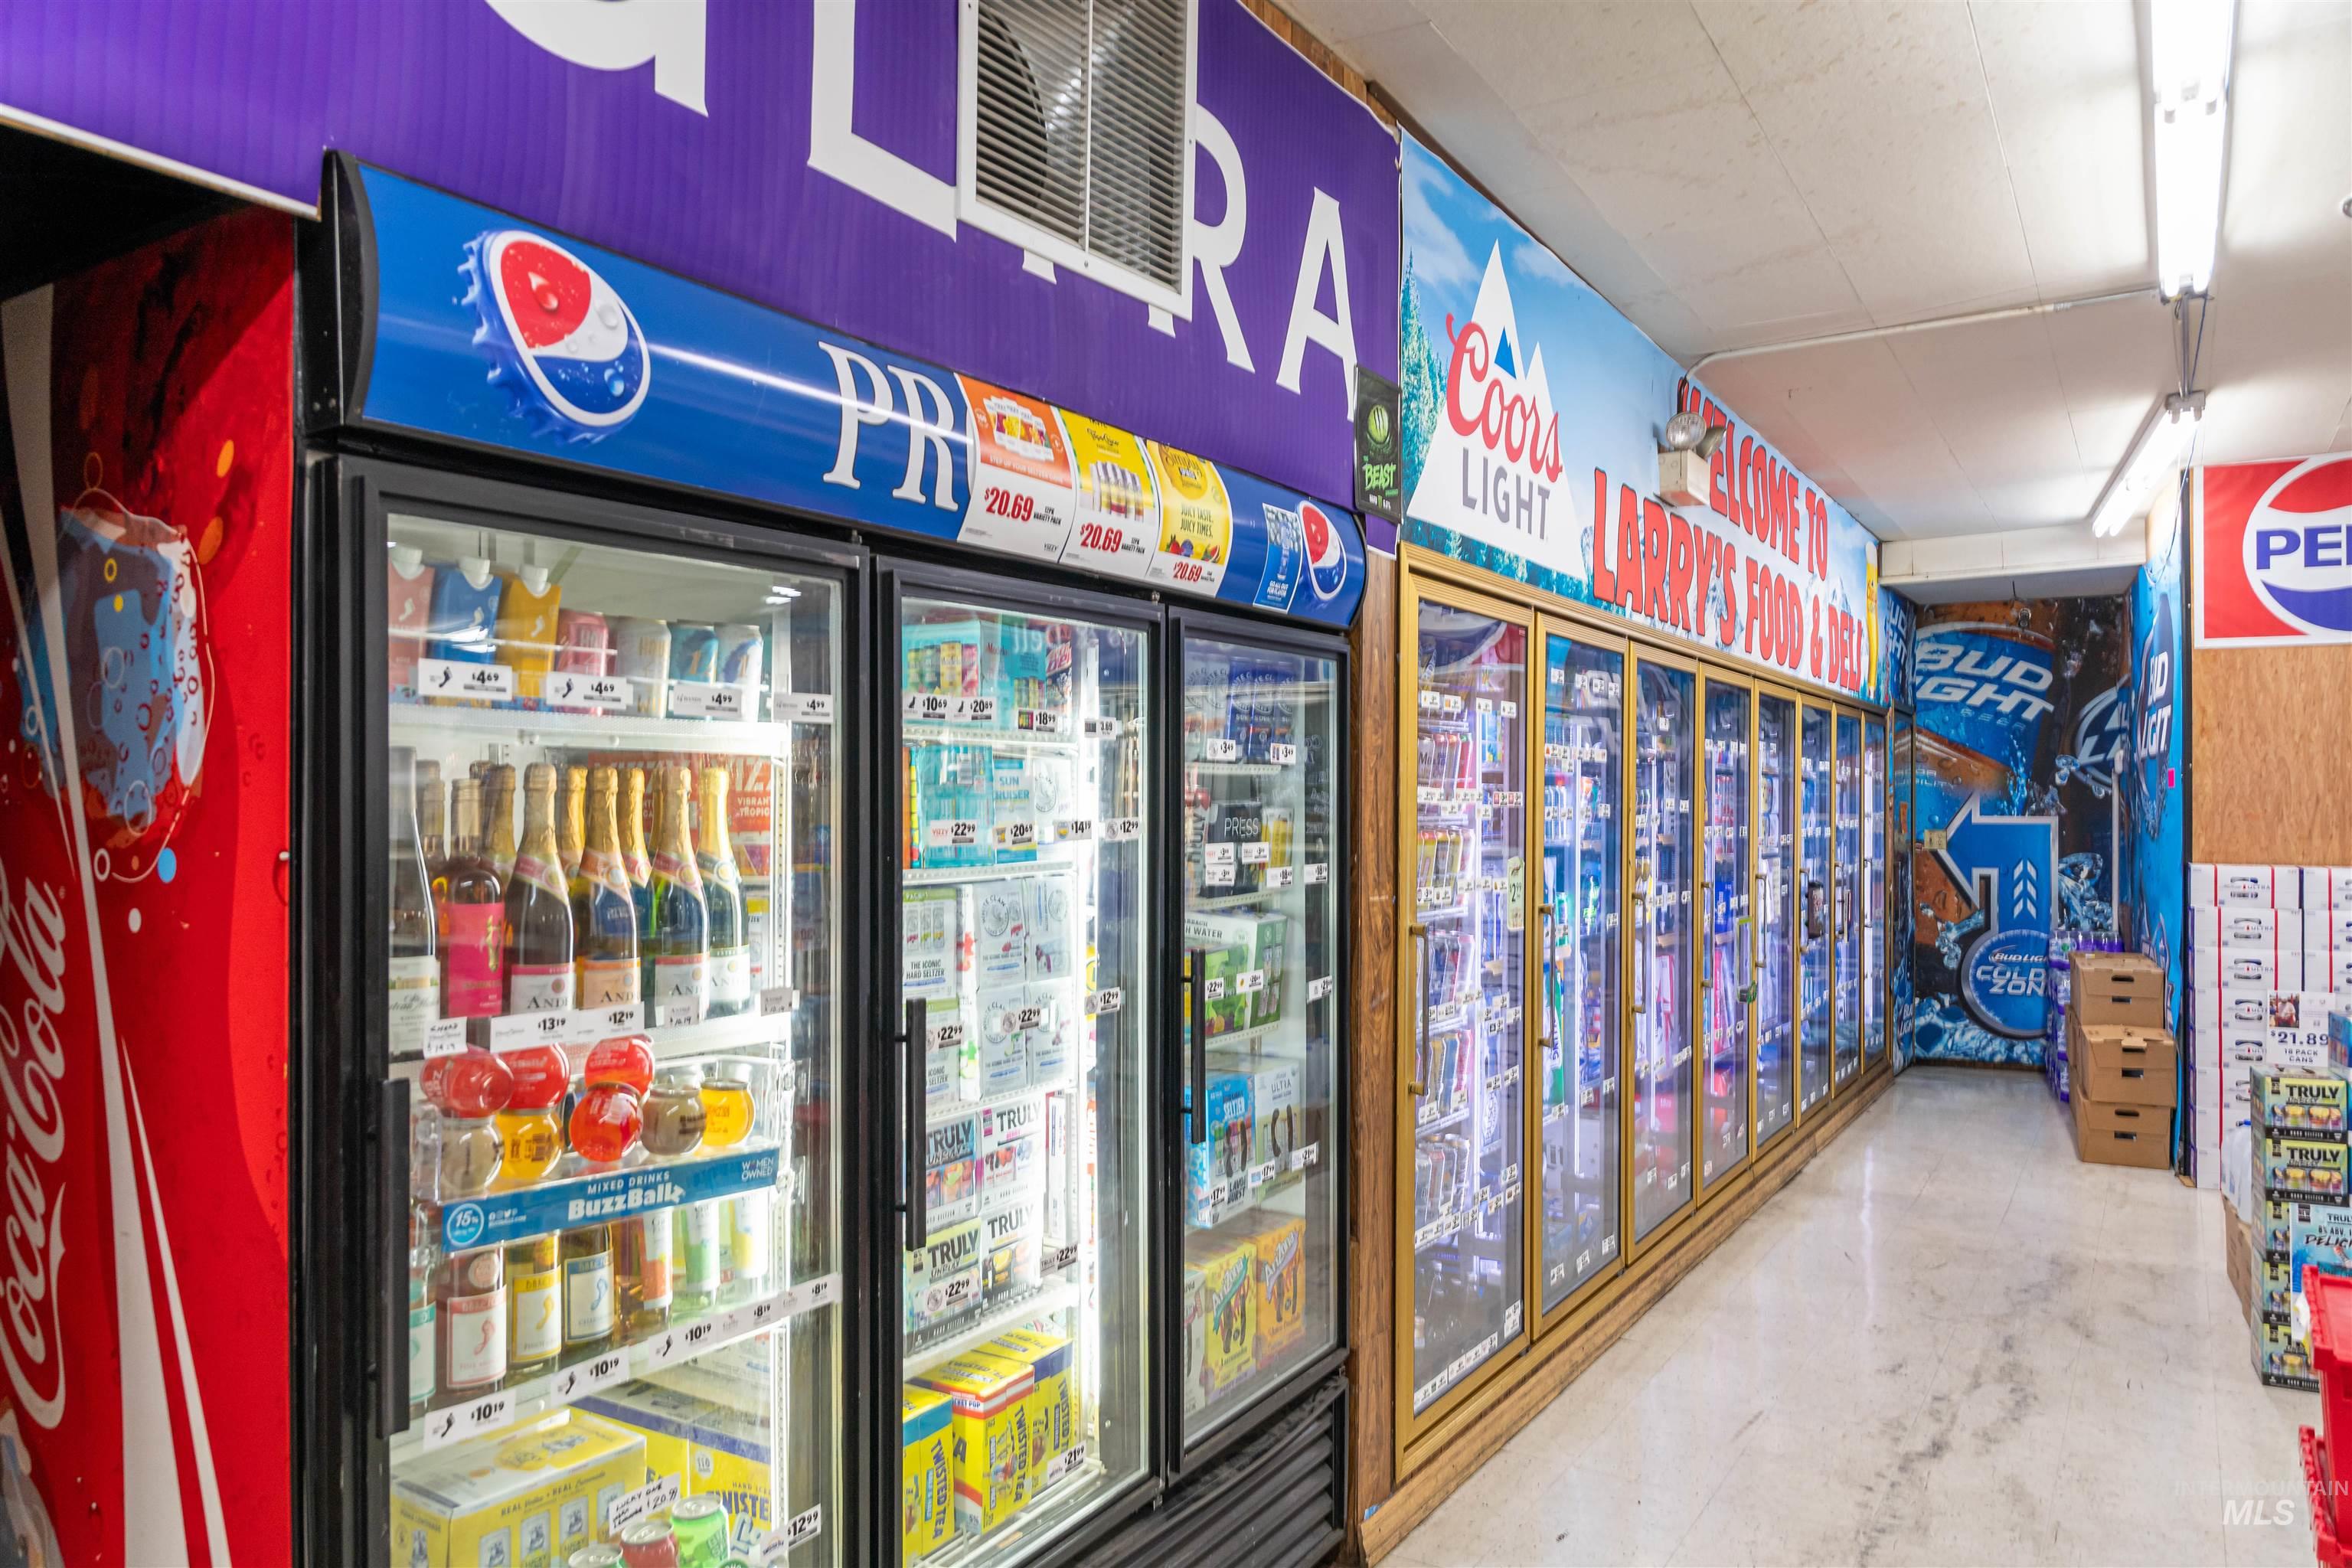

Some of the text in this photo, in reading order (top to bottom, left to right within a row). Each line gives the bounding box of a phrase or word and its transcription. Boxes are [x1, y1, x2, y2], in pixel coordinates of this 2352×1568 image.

[1446, 312, 1563, 483] Coors
[1362, 462, 1396, 491] BEAST
[1462, 447, 1550, 541] LIGHT
[985, 487, 1034, 522] $20.69
[1181, 503, 1195, 519] JUICY
[1034, 509, 1061, 526] VARIETY PACK
[1080, 522, 1123, 553] $20.69
[1180, 518, 1214, 538] JUICY TIMES.
[1805, 486, 1828, 582] TO
[1122, 543, 1145, 554] VARIETY PACK
[1174, 561, 1203, 583] $20.69
[1593, 466, 1862, 691] LARRY'S FOOD & DELI
[1916, 641, 2053, 692] BUD
[999, 776, 1019, 786] SUN
[932, 828, 949, 836] VIZZY
[1224, 816, 1259, 838] PRESS
[1193, 928, 1223, 939] WATER
[906, 968, 945, 980] HARD SELTZER
[910, 959, 941, 970] THE ICONIC
[1976, 965, 2047, 982] COLD
[1989, 978, 2047, 997] ZON
[2270, 1030, 2329, 1046] $21.89
[928, 1066, 946, 1076] ICONIC
[928, 1073, 949, 1086] SELTZER
[2285, 1083, 2340, 1099] TRULY
[996, 1101, 1041, 1132] TRULY
[1223, 1096, 1245, 1117] SELTZER
[2286, 1146, 2341, 1162] TRULY
[587, 1171, 670, 1194] MIXED DRINKS
[741, 1168, 773, 1181] OWNED
[987, 1204, 1034, 1239] TRULY
[2327, 1213, 2352, 1223] TRUL
[927, 1230, 979, 1264] TRULY
[1013, 1404, 1028, 1503] TWISTED TEA
[732, 1481, 753, 1490] HARD
[930, 1438, 948, 1540] TWISTED TEA
[501, 1502, 521, 1517] REAL
[552, 1482, 572, 1496] REAL
